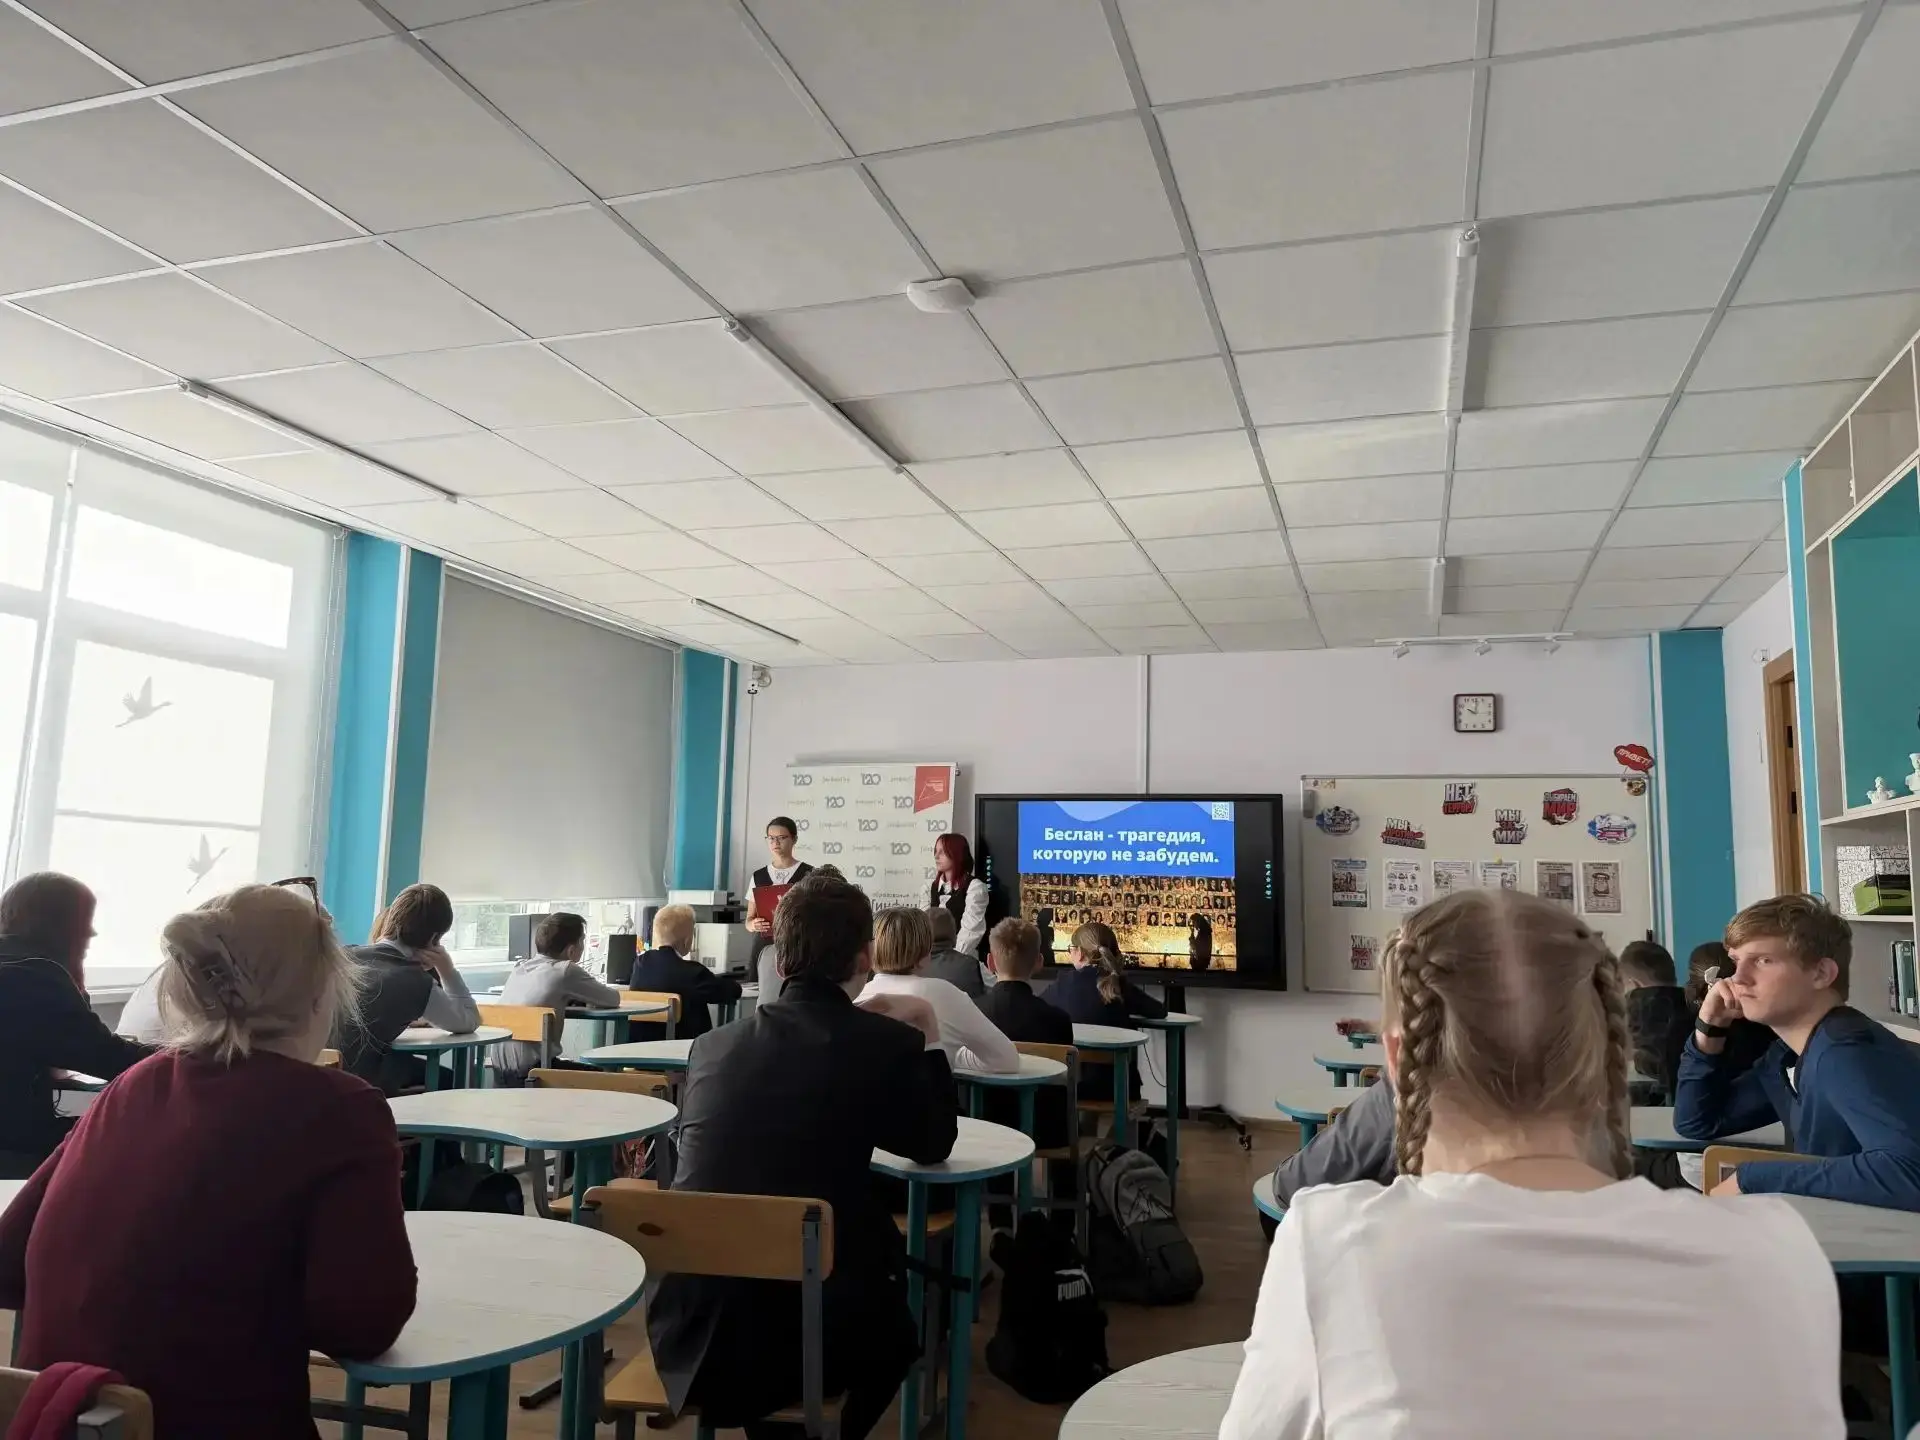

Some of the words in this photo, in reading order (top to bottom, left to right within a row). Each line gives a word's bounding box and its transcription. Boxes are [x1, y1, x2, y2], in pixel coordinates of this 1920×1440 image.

[1444, 783, 1473, 802] НЕТ
[1495, 809, 1521, 822] МЫ
[1543, 802, 1577, 818] МИР
[1386, 817, 1410, 830] МЫ
[1044, 827, 1104, 842] Беслан
[1117, 829, 1207, 846] трагедия,
[1494, 830, 1525, 844] МИР
[1032, 848, 1108, 865] которую
[1111, 850, 1133, 862] не
[1136, 849, 1220, 866] забудем.
[1058, 1279, 1086, 1301] PUMA
